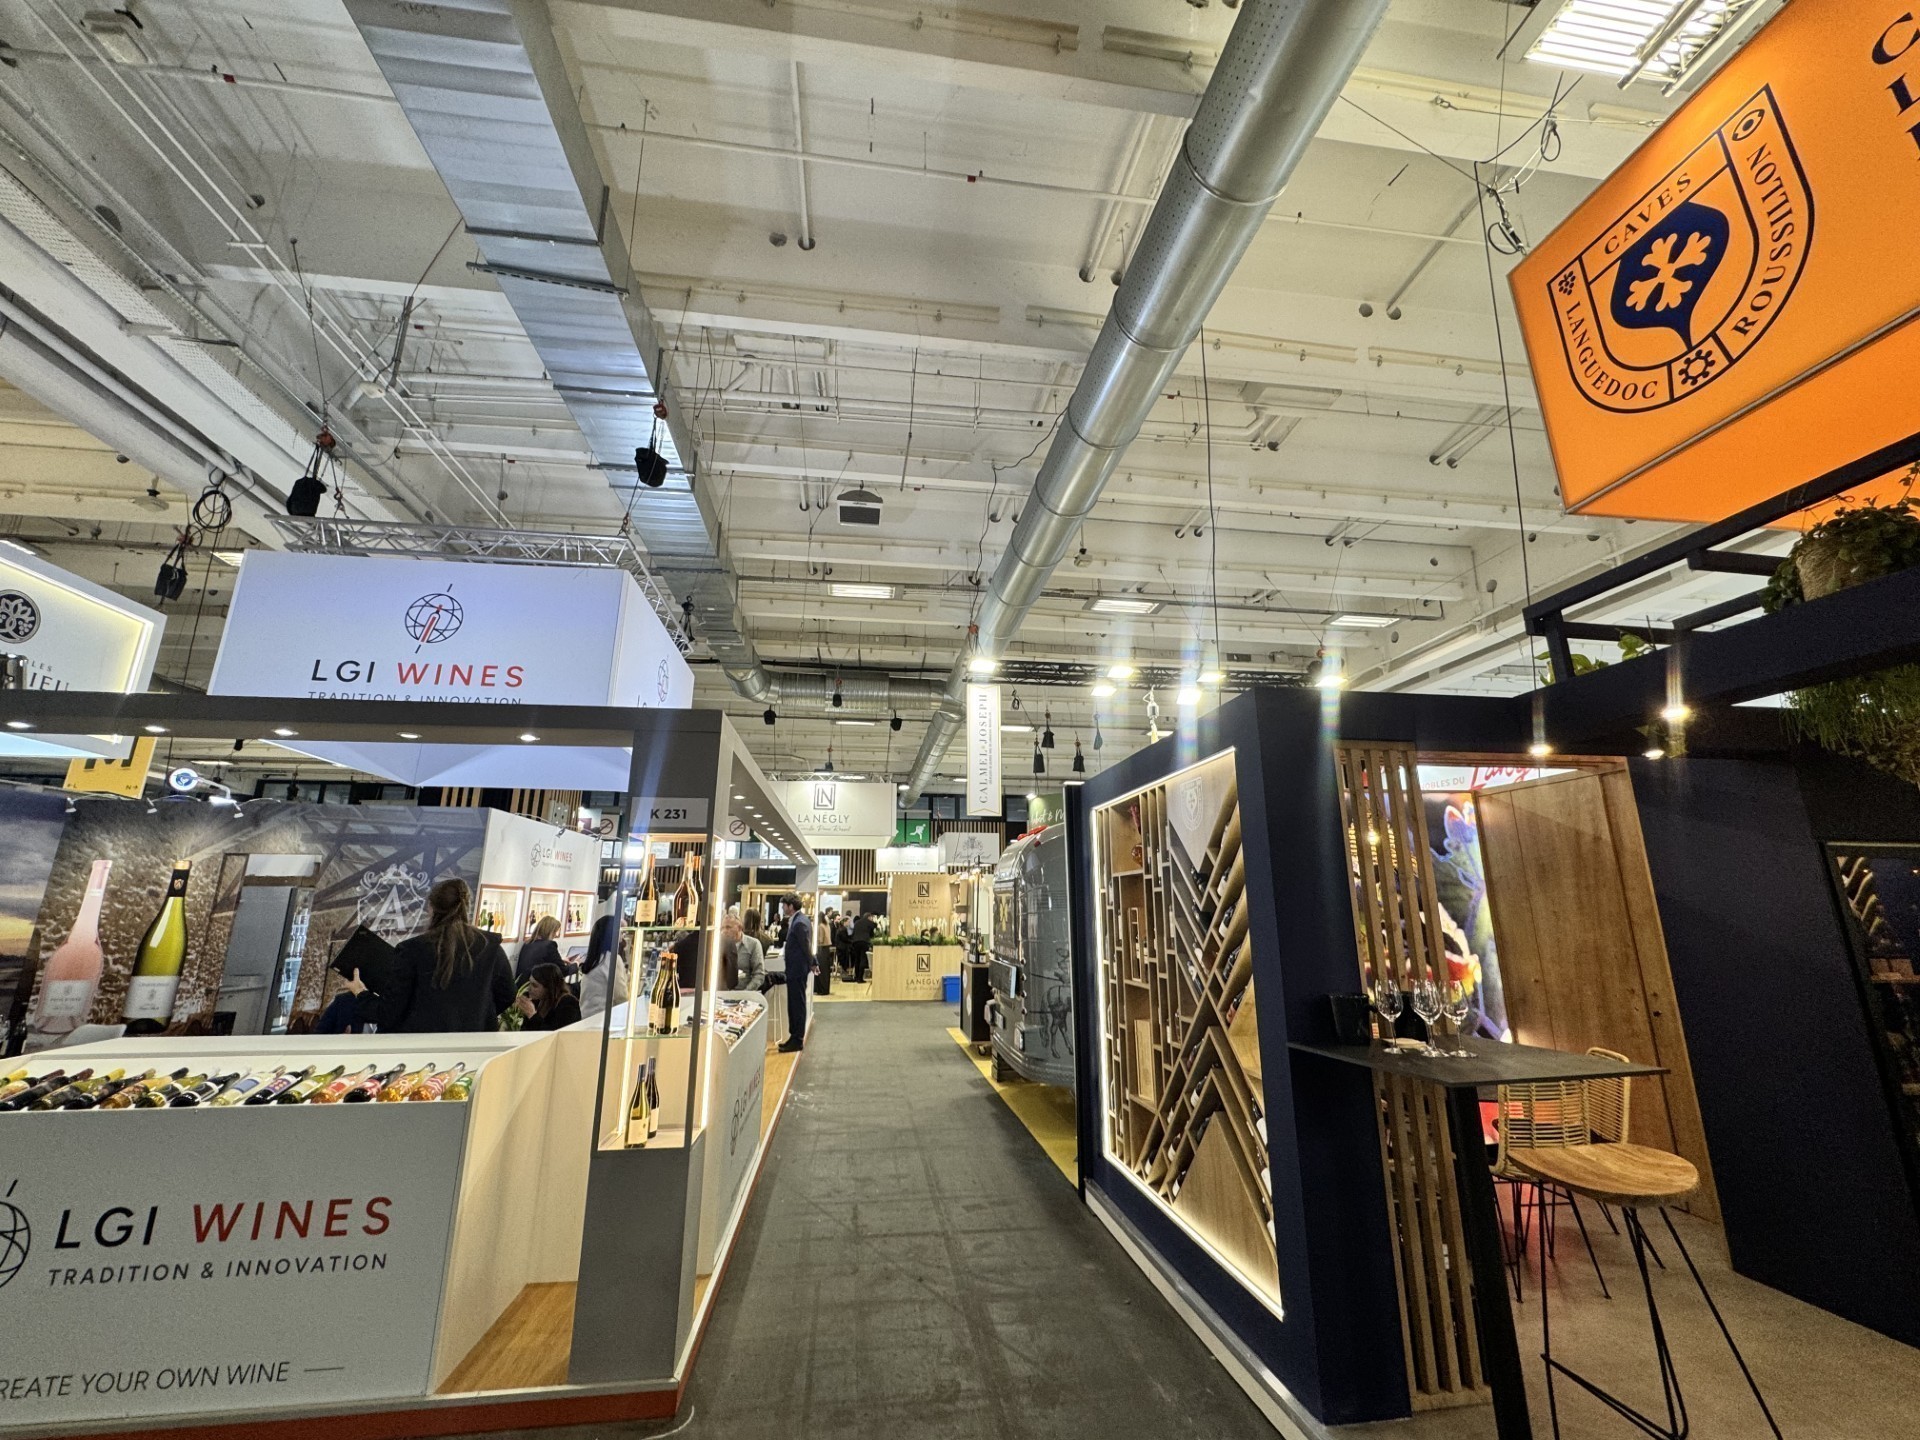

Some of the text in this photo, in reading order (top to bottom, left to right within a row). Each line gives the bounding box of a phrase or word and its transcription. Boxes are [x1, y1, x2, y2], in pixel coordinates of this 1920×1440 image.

[1604, 172, 1692, 255] CAVES
[1732, 143, 1795, 337] ROUSSILLON
[1565, 304, 1659, 402] LANGUEDOC
[311, 659, 525, 688] LGI WINES
[308, 691, 397, 702] TRADITION
[420, 695, 522, 705] INNOVATION
[978, 693, 988, 803] CALMEL JOSEPH
[1422, 778, 1450, 790] OBLES
[1453, 776, 1465, 786] DU
[650, 808, 687, 820] K 231
[797, 814, 810, 823] LA
[555, 850, 573, 863] WINES
[54, 1196, 395, 1249] LGI WINES
[48, 1253, 389, 1287] TRADITION & INNOVATION
[0, 1361, 291, 1400] REATE YOUR OWN WINE
